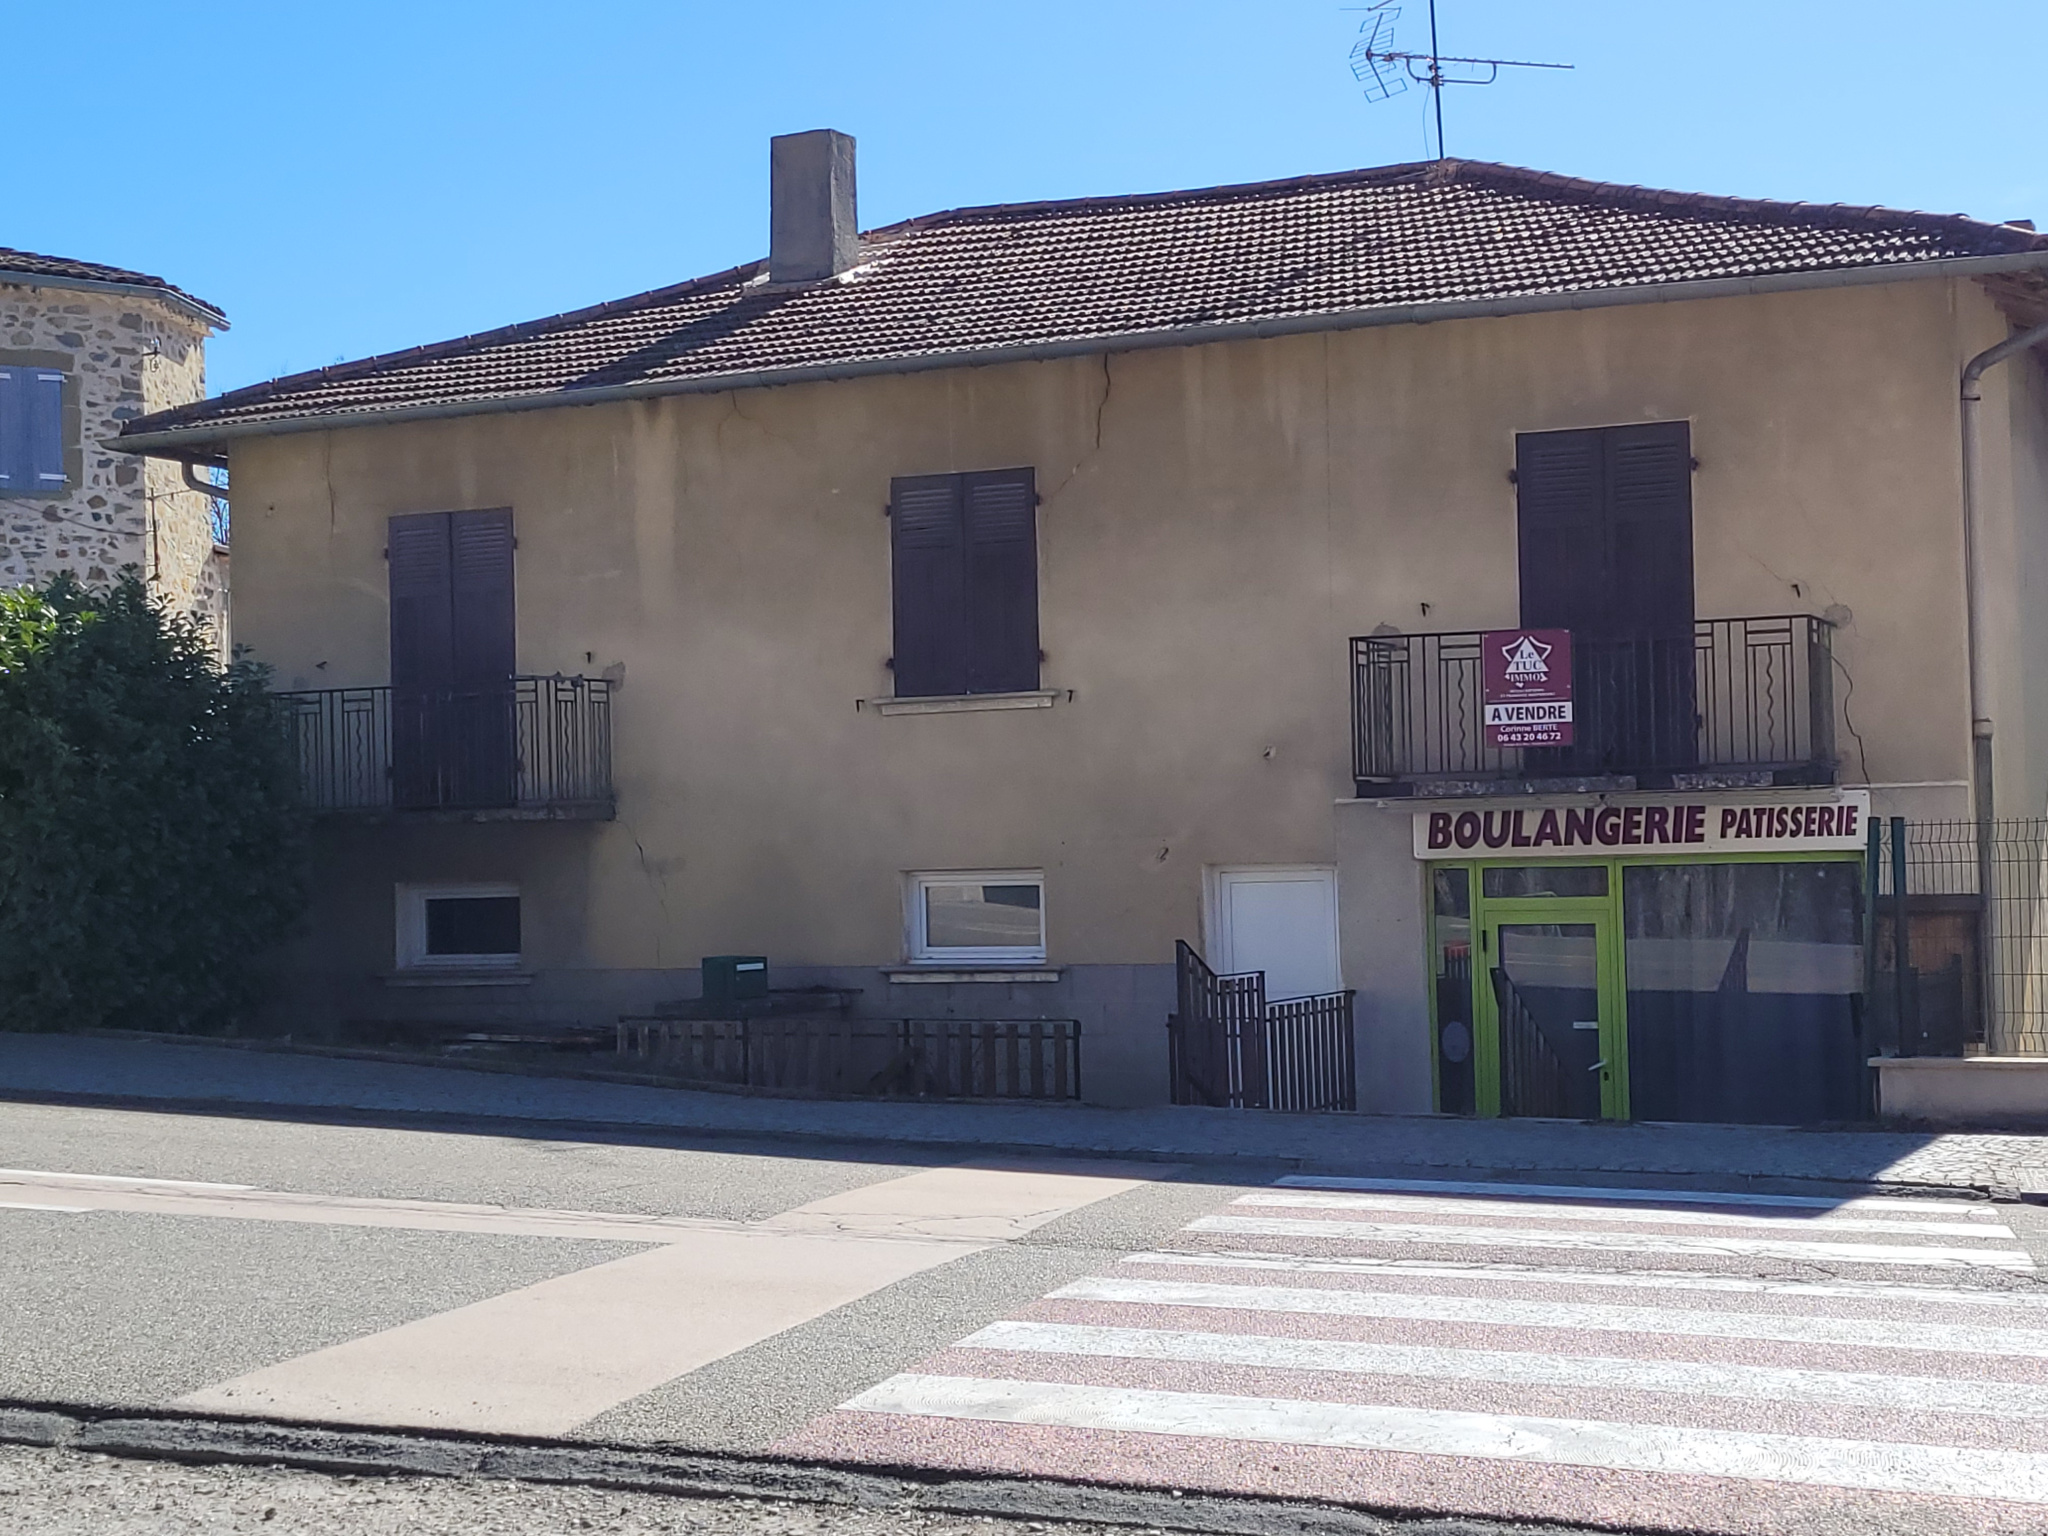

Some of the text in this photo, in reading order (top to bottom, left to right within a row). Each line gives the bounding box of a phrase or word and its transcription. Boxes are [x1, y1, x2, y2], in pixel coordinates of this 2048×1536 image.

[1520, 650, 1534, 659] Le
[1513, 660, 1542, 671] TUC
[1510, 673, 1541, 682] IMMO
[1491, 705, 1567, 721] A VENDRE
[1497, 732, 1562, 742] 06 43 20 46 72
[1427, 805, 1859, 850] BOULANGERIE PATISSERIE
